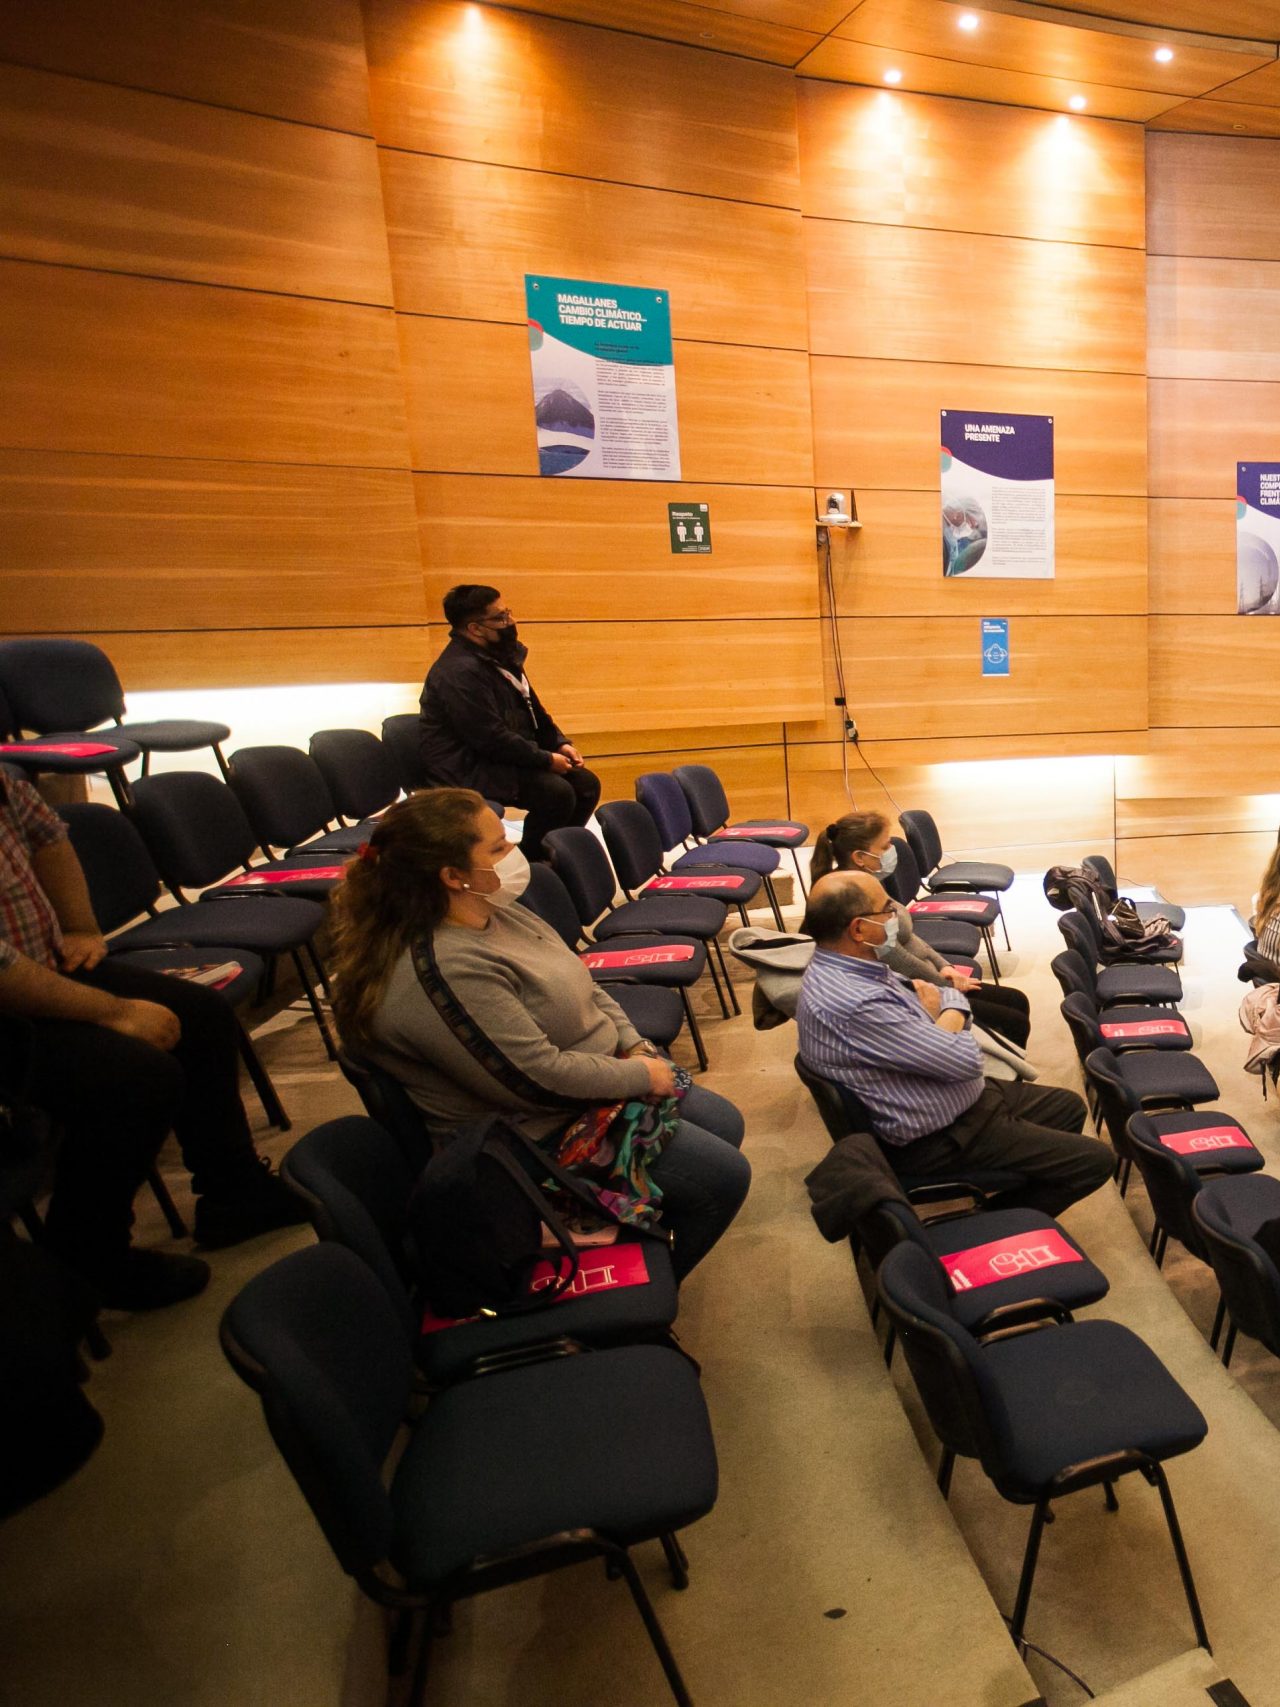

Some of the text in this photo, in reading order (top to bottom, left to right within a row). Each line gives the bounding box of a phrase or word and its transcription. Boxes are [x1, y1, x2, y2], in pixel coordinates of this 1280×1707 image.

[557, 293, 618, 308] MAGALLANES
[558, 304, 594, 317] CAMBIO
[559, 314, 642, 331] TIEMPO DE ACTUAR
[964, 423, 1016, 435] UNA AMENAZA
[964, 432, 1001, 443] PRESENTE
